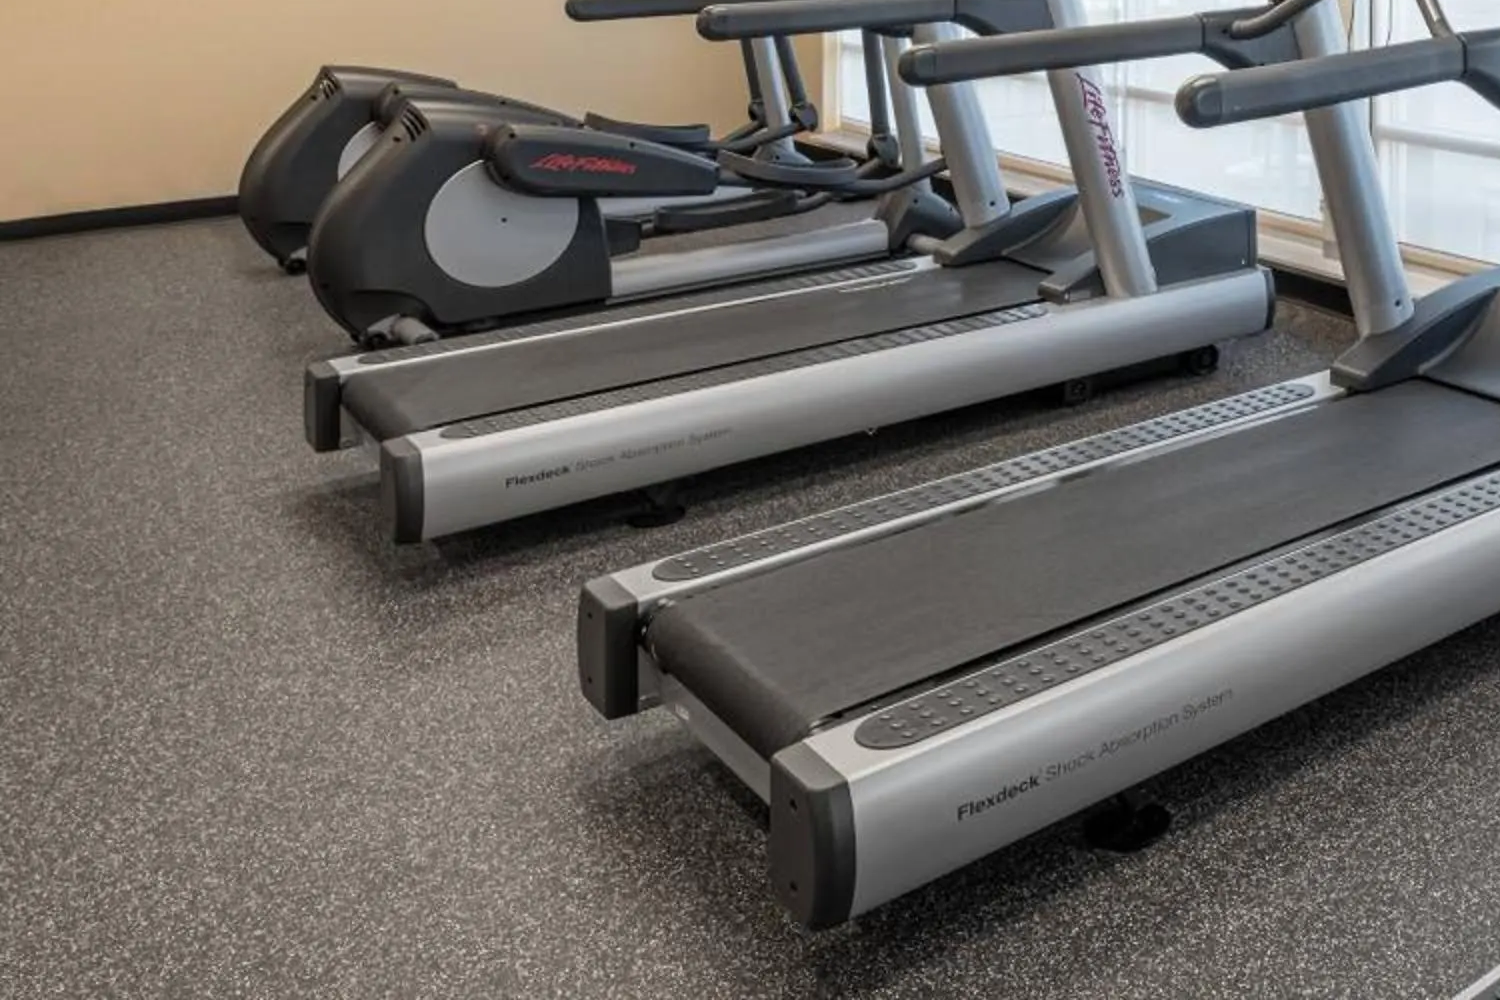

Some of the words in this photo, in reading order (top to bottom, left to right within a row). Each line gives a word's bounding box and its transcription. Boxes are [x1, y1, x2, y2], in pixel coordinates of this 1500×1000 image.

[505, 465, 571, 489] Flexdeck
[956, 775, 1041, 822] Flexdeck
[1044, 751, 1096, 782] Shock
[1099, 712, 1179, 758] Absorption
